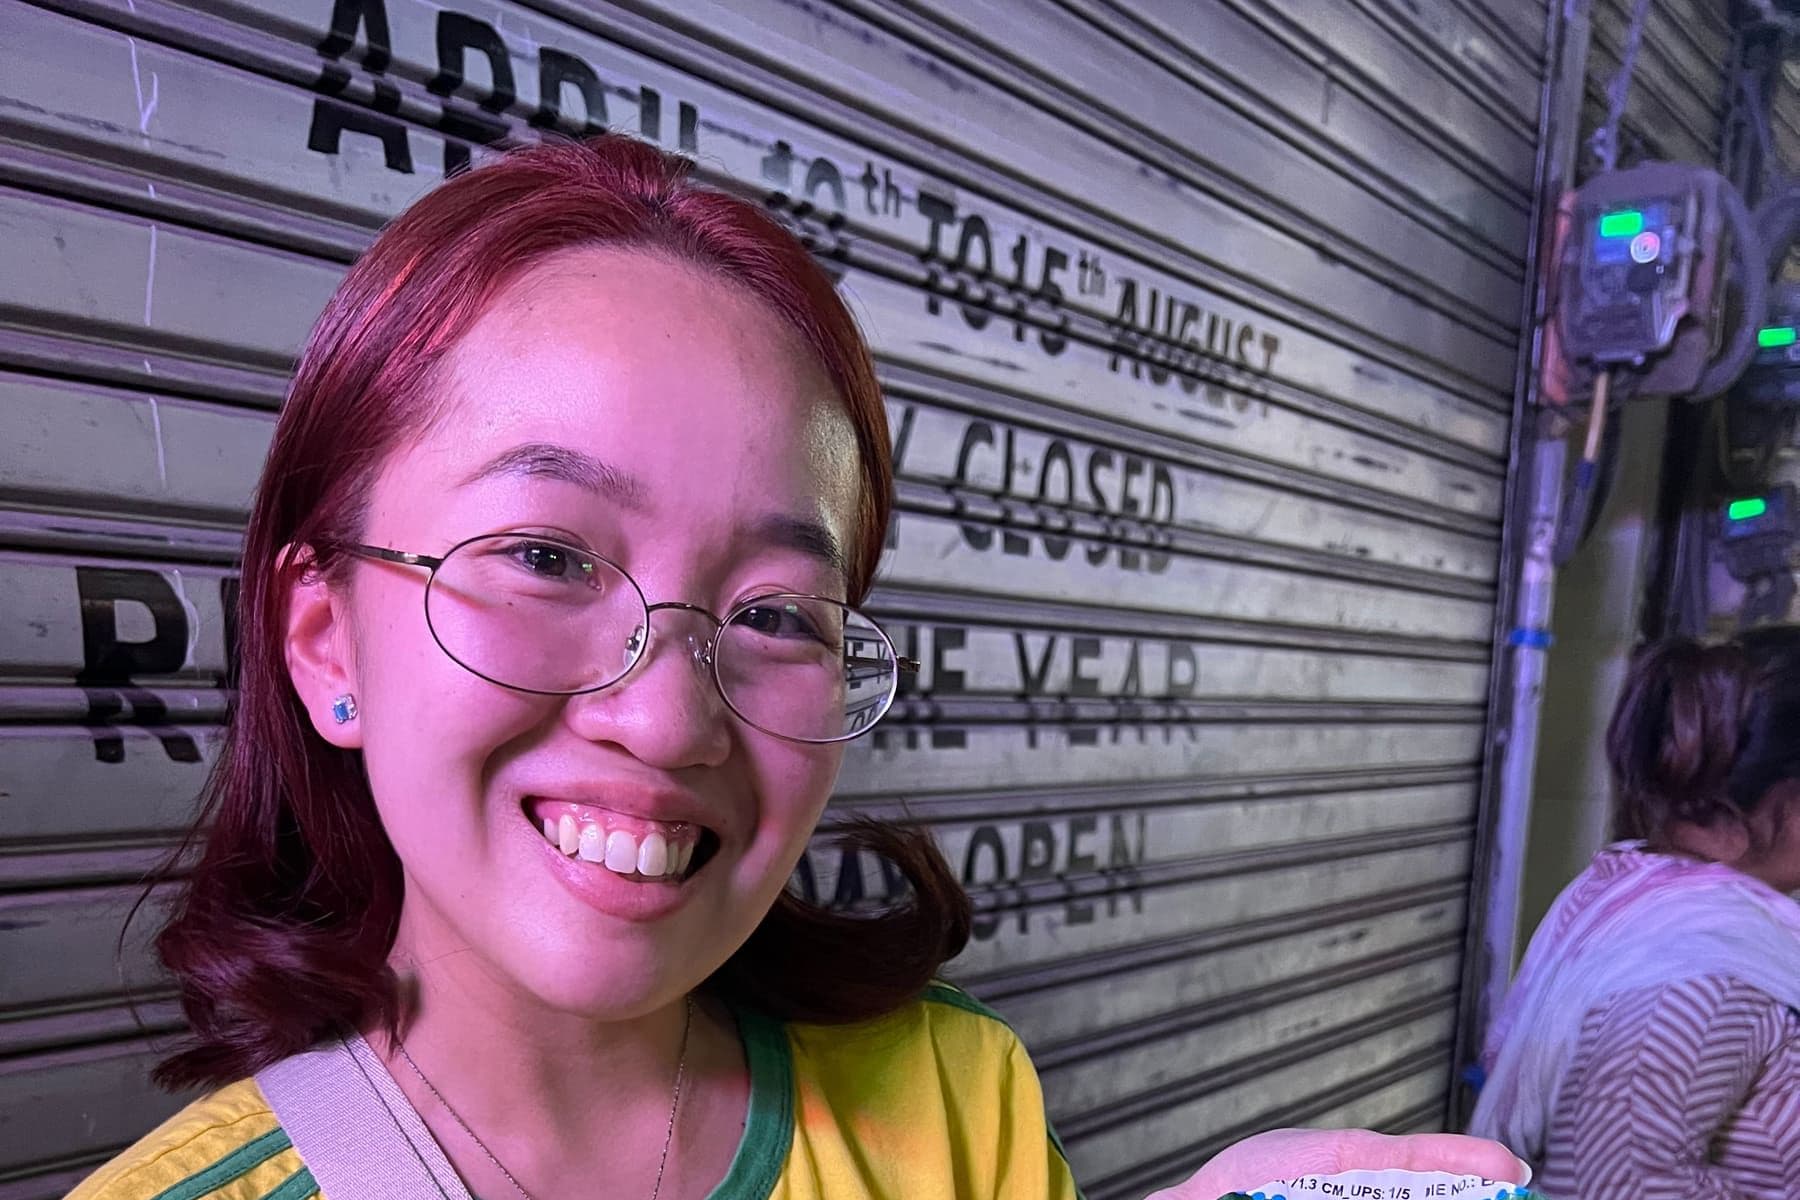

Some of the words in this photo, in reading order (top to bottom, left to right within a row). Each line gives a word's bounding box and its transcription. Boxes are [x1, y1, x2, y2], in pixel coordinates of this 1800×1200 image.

[1106, 278, 1281, 418] AUGUST
[947, 420, 1178, 576] CLOSED
[1012, 632, 1199, 750] YEAR
[961, 812, 1148, 942] OPEN
